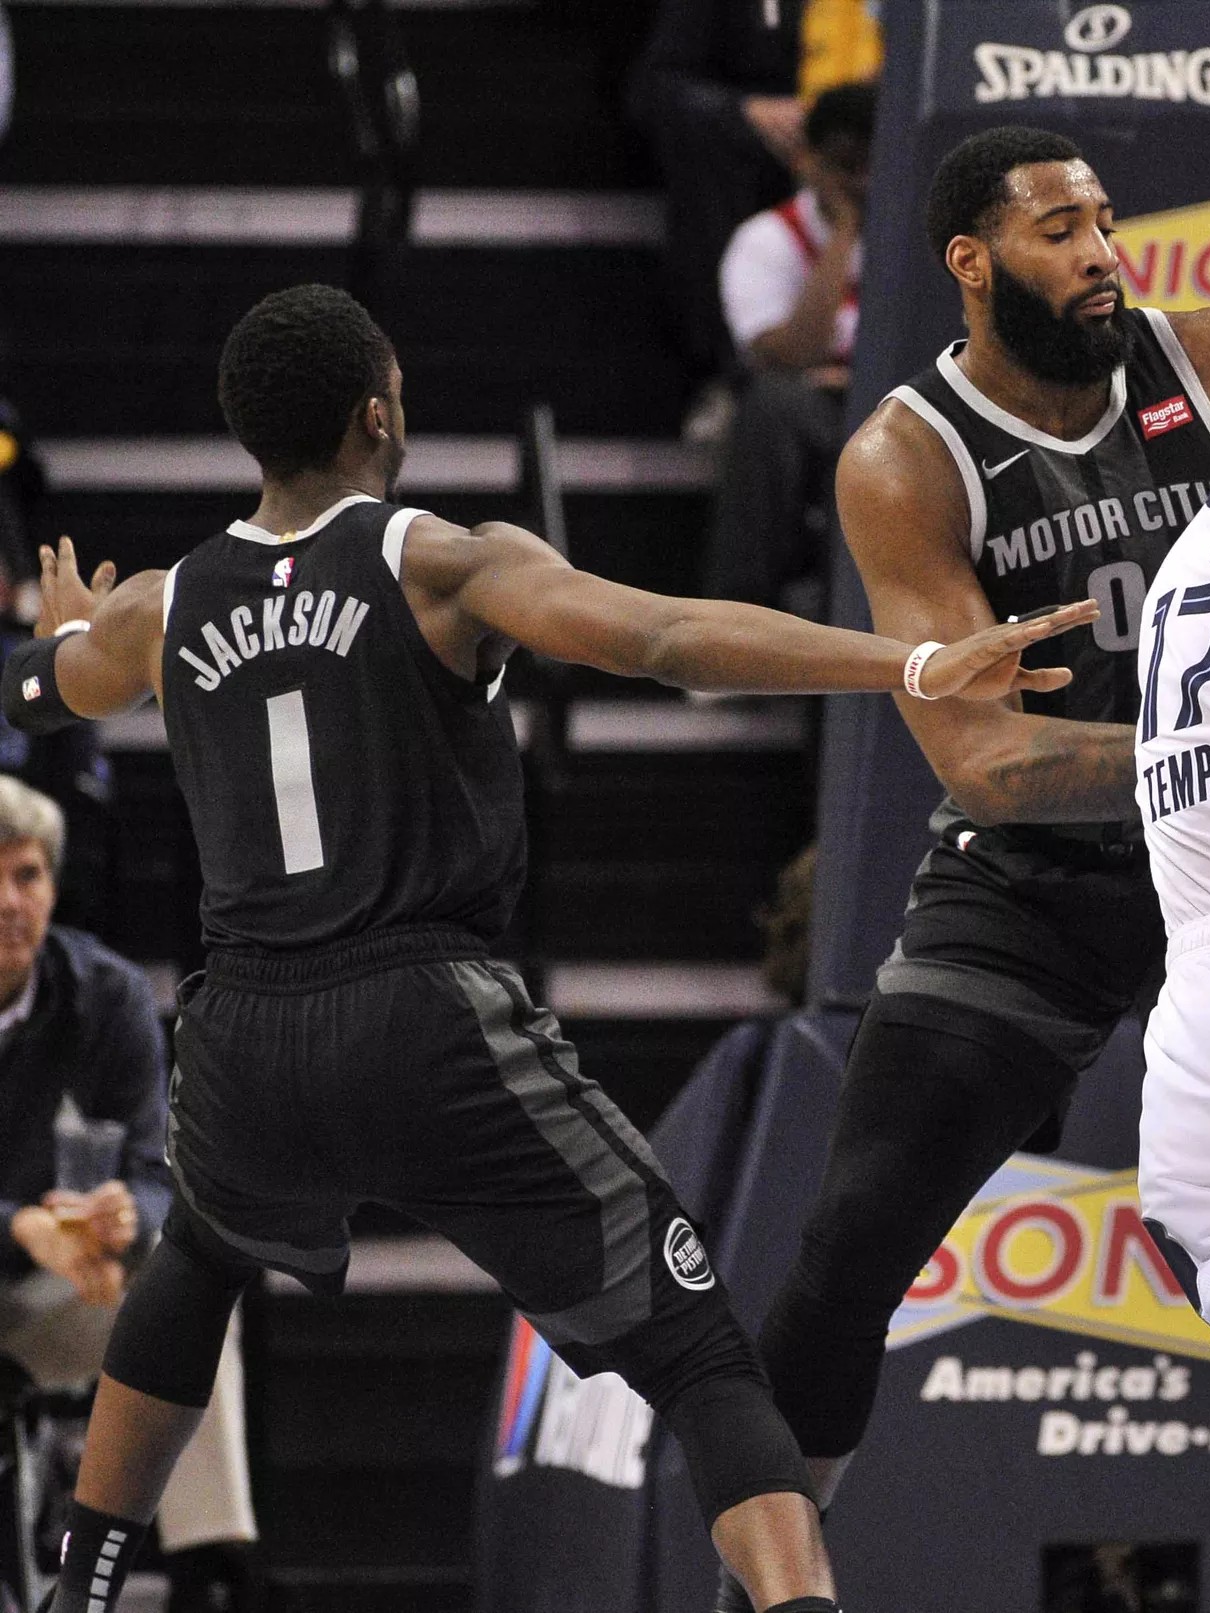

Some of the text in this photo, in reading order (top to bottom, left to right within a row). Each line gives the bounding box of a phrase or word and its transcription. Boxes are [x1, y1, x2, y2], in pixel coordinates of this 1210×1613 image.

[1142, 401, 1185, 425] Flagstar
[986, 498, 1130, 576] MOTOR
[178, 590, 370, 691] JACKSON
[1087, 561, 1147, 652] 0
[266, 689, 324, 874] 1
[920, 1352, 1192, 1401] America's
